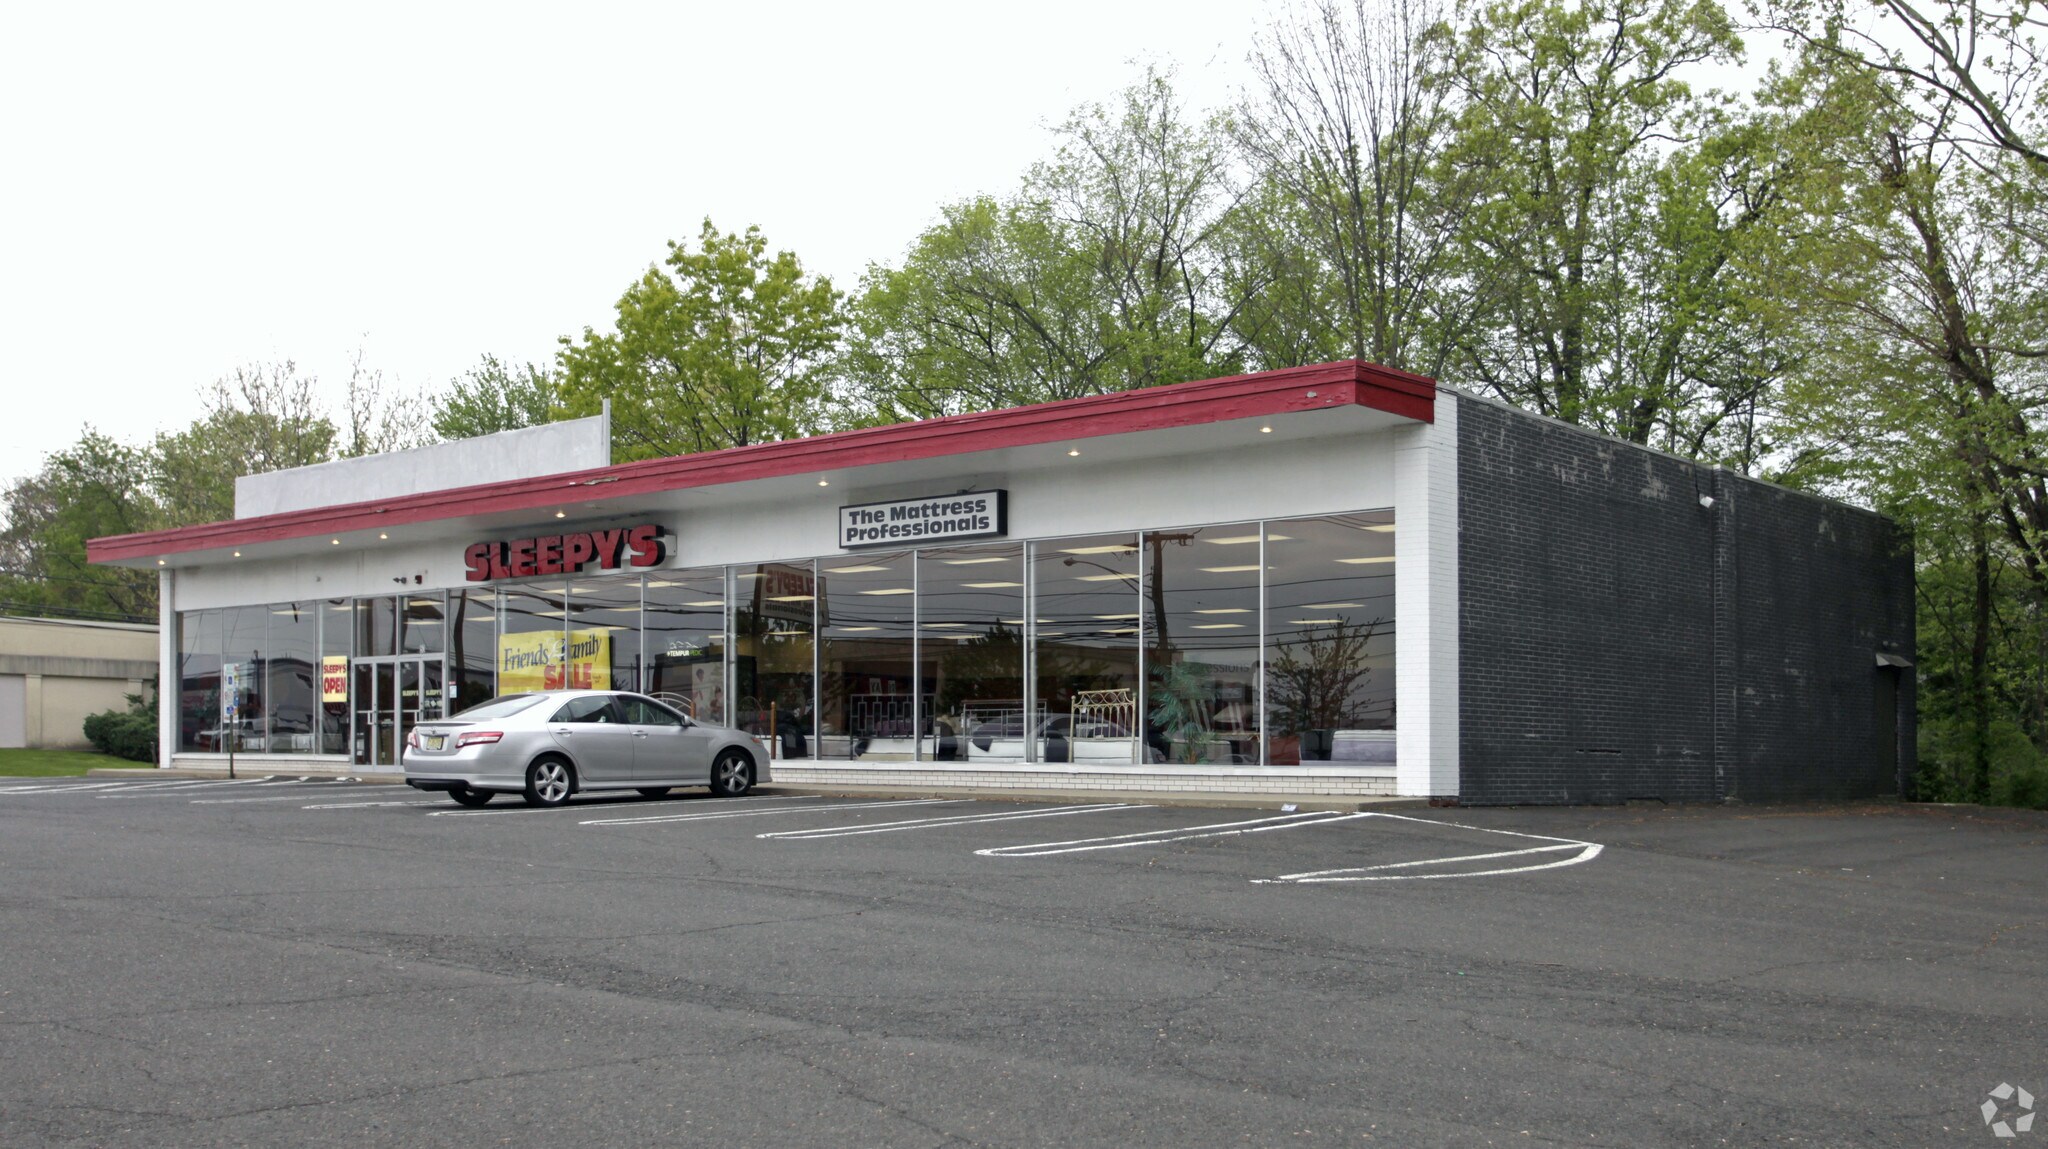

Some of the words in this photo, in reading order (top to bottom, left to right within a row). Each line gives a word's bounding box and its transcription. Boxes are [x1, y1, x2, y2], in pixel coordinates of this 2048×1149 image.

[849, 509, 886, 526] The
[890, 499, 987, 522] Mattress
[846, 515, 990, 542] Professionals
[464, 525, 665, 582] SLEEPY'S
[323, 663, 347, 674] SLEEPY'S
[503, 643, 549, 672] Friends
[323, 676, 347, 694] OPEN
